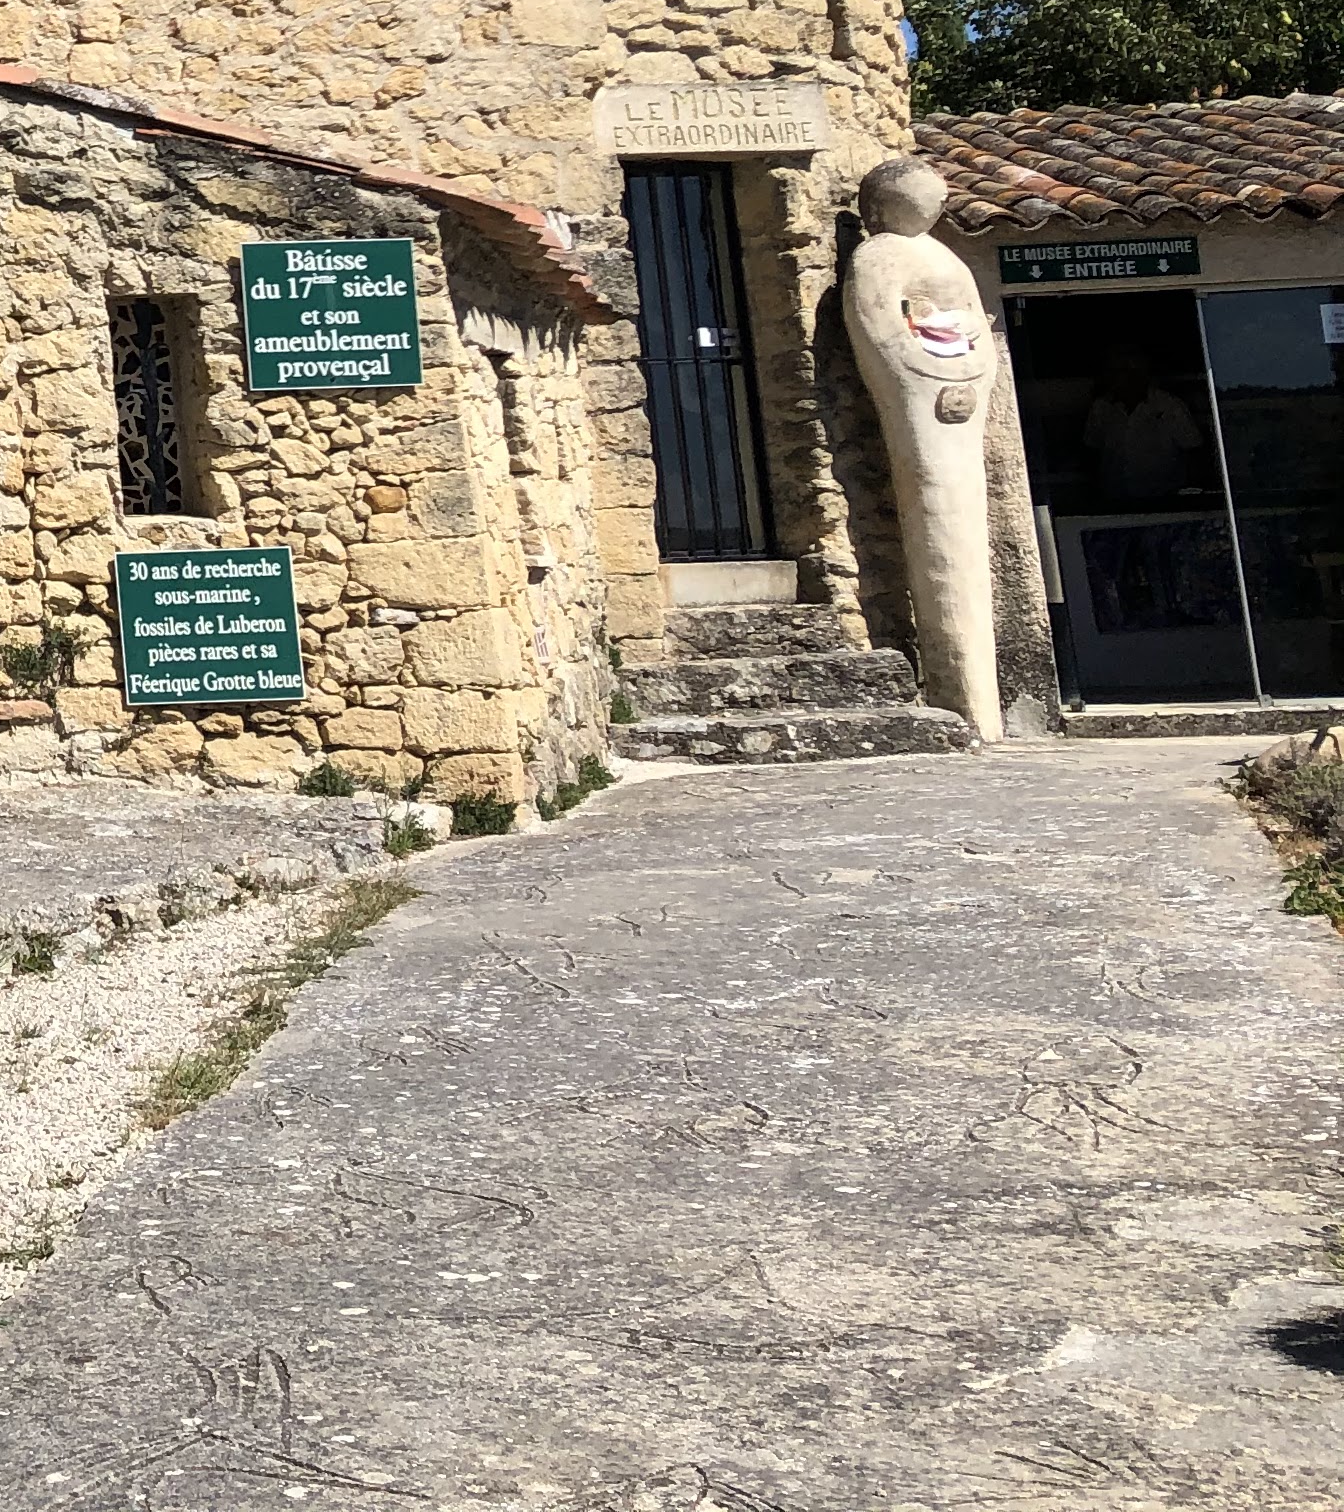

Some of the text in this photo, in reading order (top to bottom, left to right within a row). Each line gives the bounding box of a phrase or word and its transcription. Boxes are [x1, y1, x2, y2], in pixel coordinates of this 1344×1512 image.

[625, 102, 664, 122] LE
[613, 121, 815, 148] EXTRAORDINAIRE
[285, 248, 368, 272] Bâtisse
[1004, 240, 1193, 262] LE MUSÉE EXTRAORDINAIRE
[1063, 258, 1137, 278] ENTRÉE
[250, 277, 282, 300] du
[342, 274, 408, 298] siècle
[300, 309, 361, 326] et son
[254, 330, 411, 353] ameublement
[277, 353, 391, 384] provençal
[128, 558, 282, 581] 30 ans de recherche
[134, 614, 287, 637] fossiles de Luberon
[148, 643, 278, 667] pièces rares et sa
[129, 670, 302, 696] Féerique Grotte bleue
